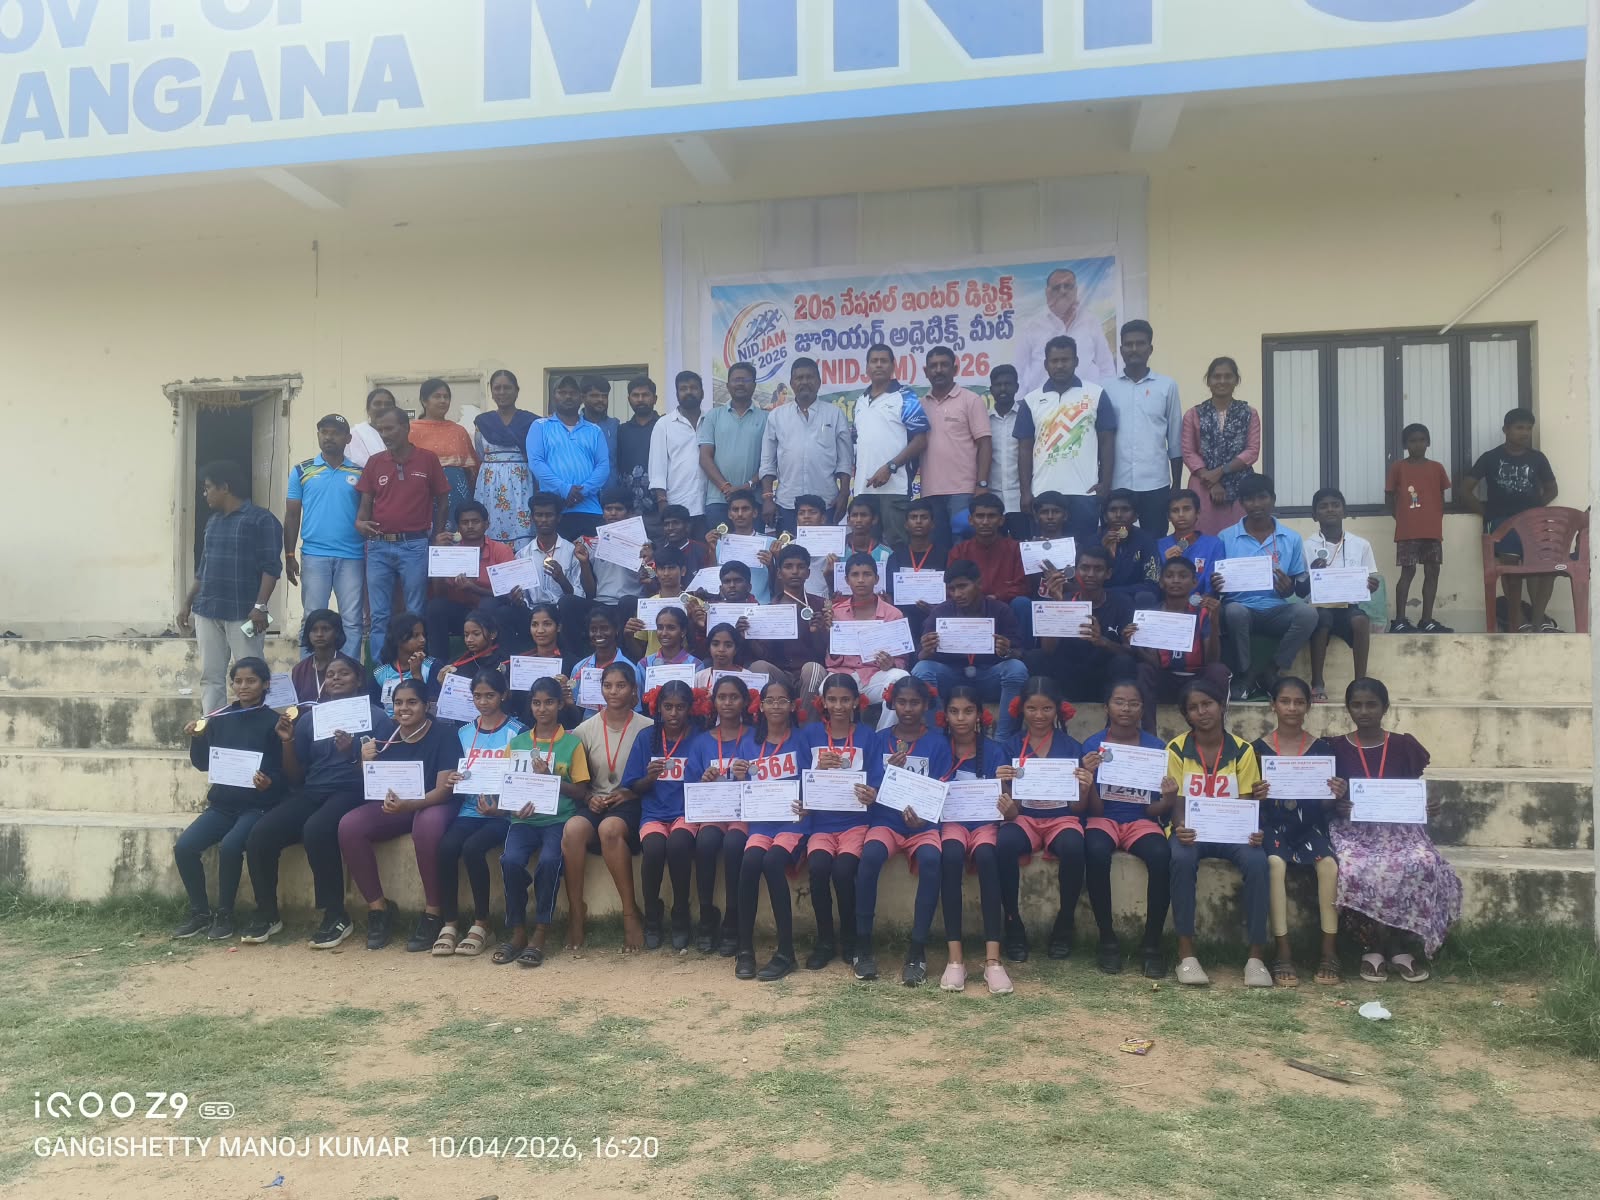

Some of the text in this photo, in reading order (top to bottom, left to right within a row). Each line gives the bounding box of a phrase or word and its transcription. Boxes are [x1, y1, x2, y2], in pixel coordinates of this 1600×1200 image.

[1, 34, 425, 145] ANGANA
[793, 293, 837, 321] 20వ
[839, 285, 899, 319] నేషనల్
[901, 280, 961, 312] ఇంటర్
[737, 329, 787, 362] NIDJAM
[794, 319, 885, 353] జూనియర్
[970, 309, 1015, 342] మీట్
[757, 346, 788, 369] 2026
[757, 753, 796, 781] 564
[1189, 774, 1231, 798] 52
